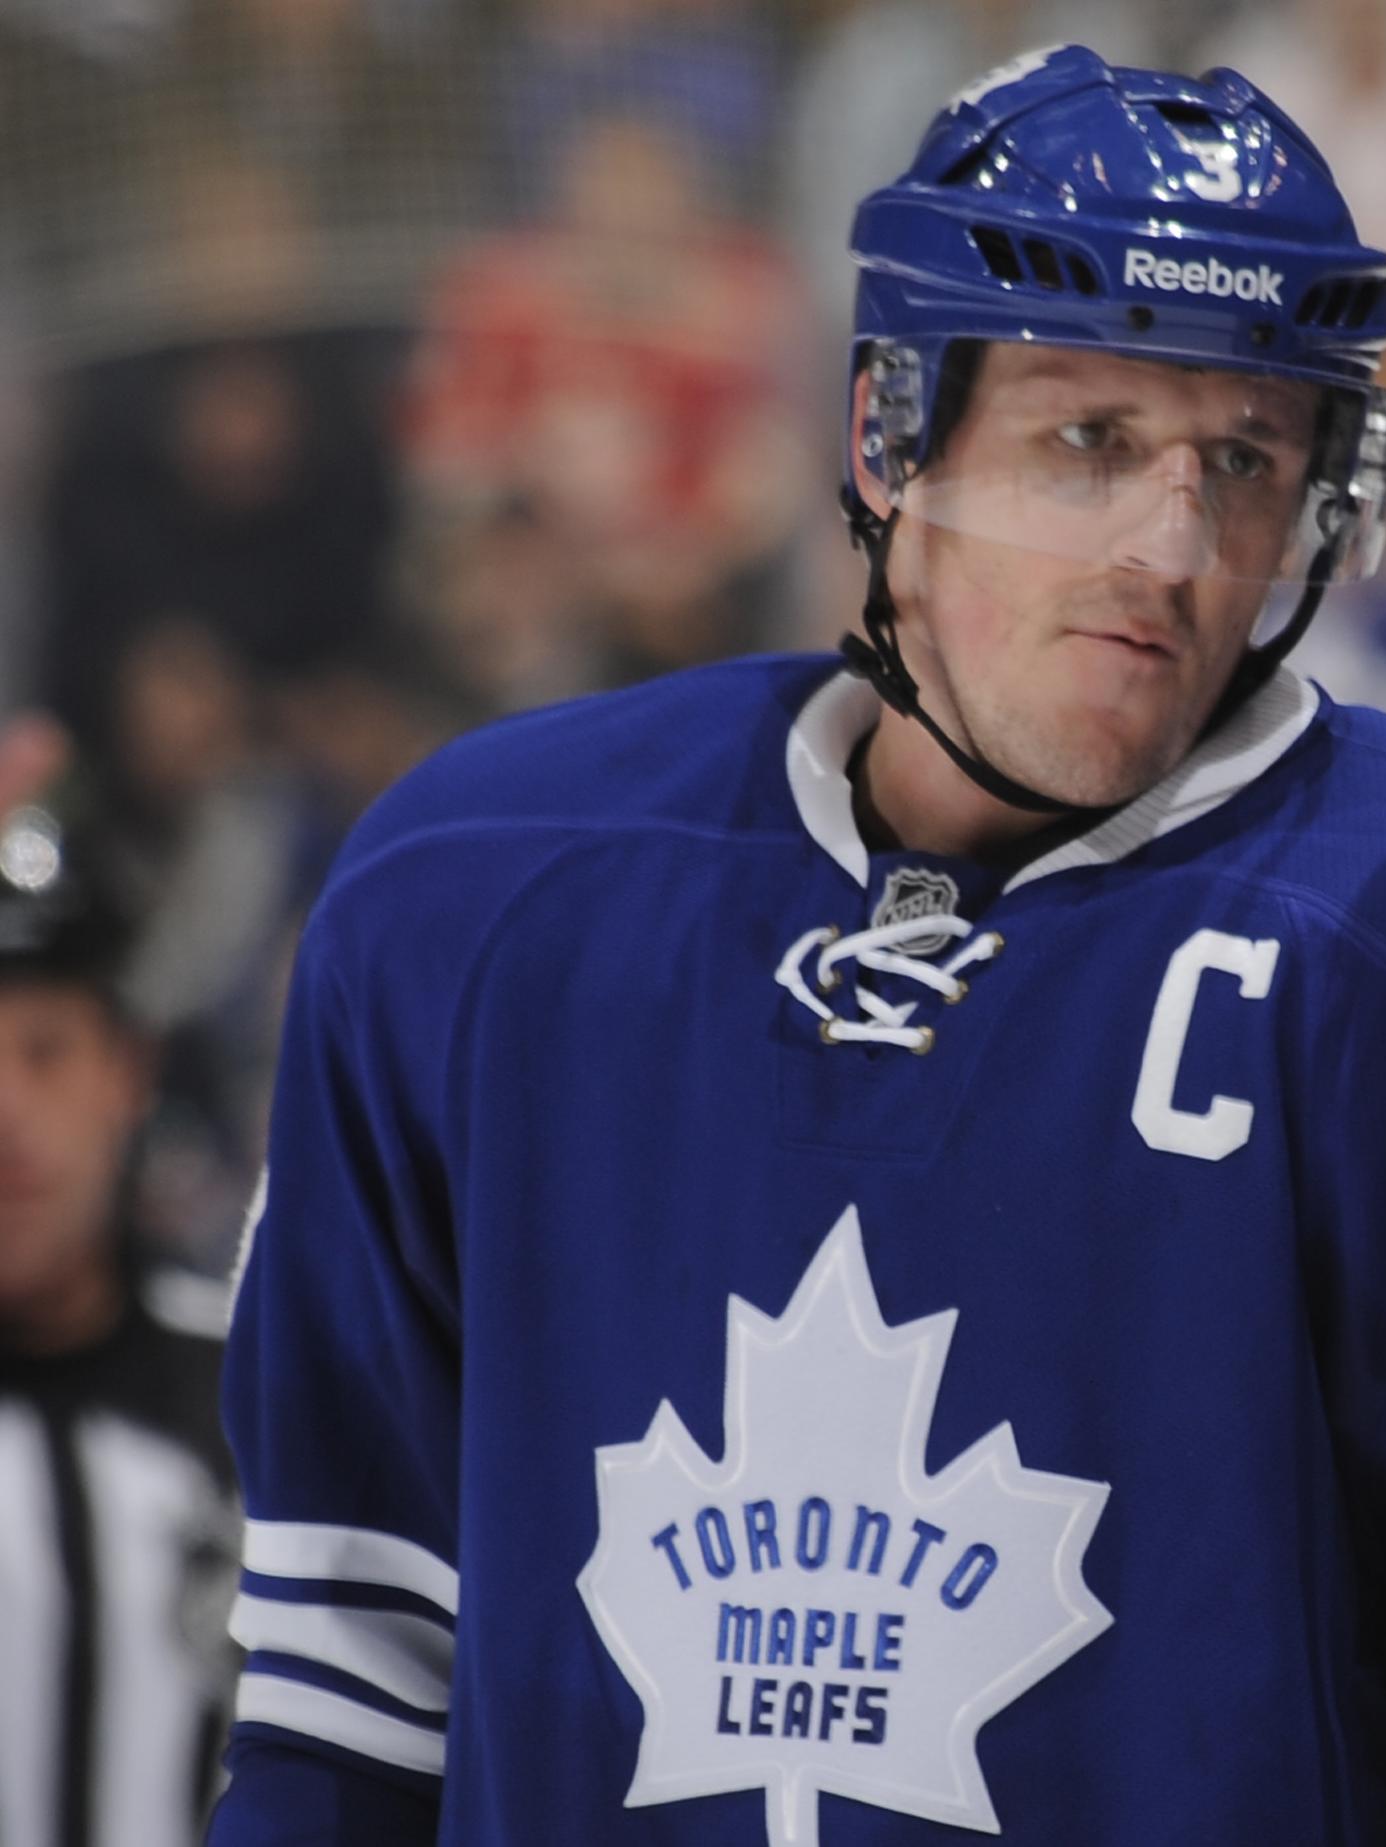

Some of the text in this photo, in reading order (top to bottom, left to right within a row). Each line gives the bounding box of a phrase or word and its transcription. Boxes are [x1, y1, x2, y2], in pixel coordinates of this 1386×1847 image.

[1184, 142, 1243, 202] 3
[1123, 248, 1284, 306] Reebok
[1131, 929, 1280, 1161] C
[650, 1496, 999, 1611] TORONTO
[715, 1602, 905, 1671] MAPLE
[715, 1676, 889, 1746] LEAFS
